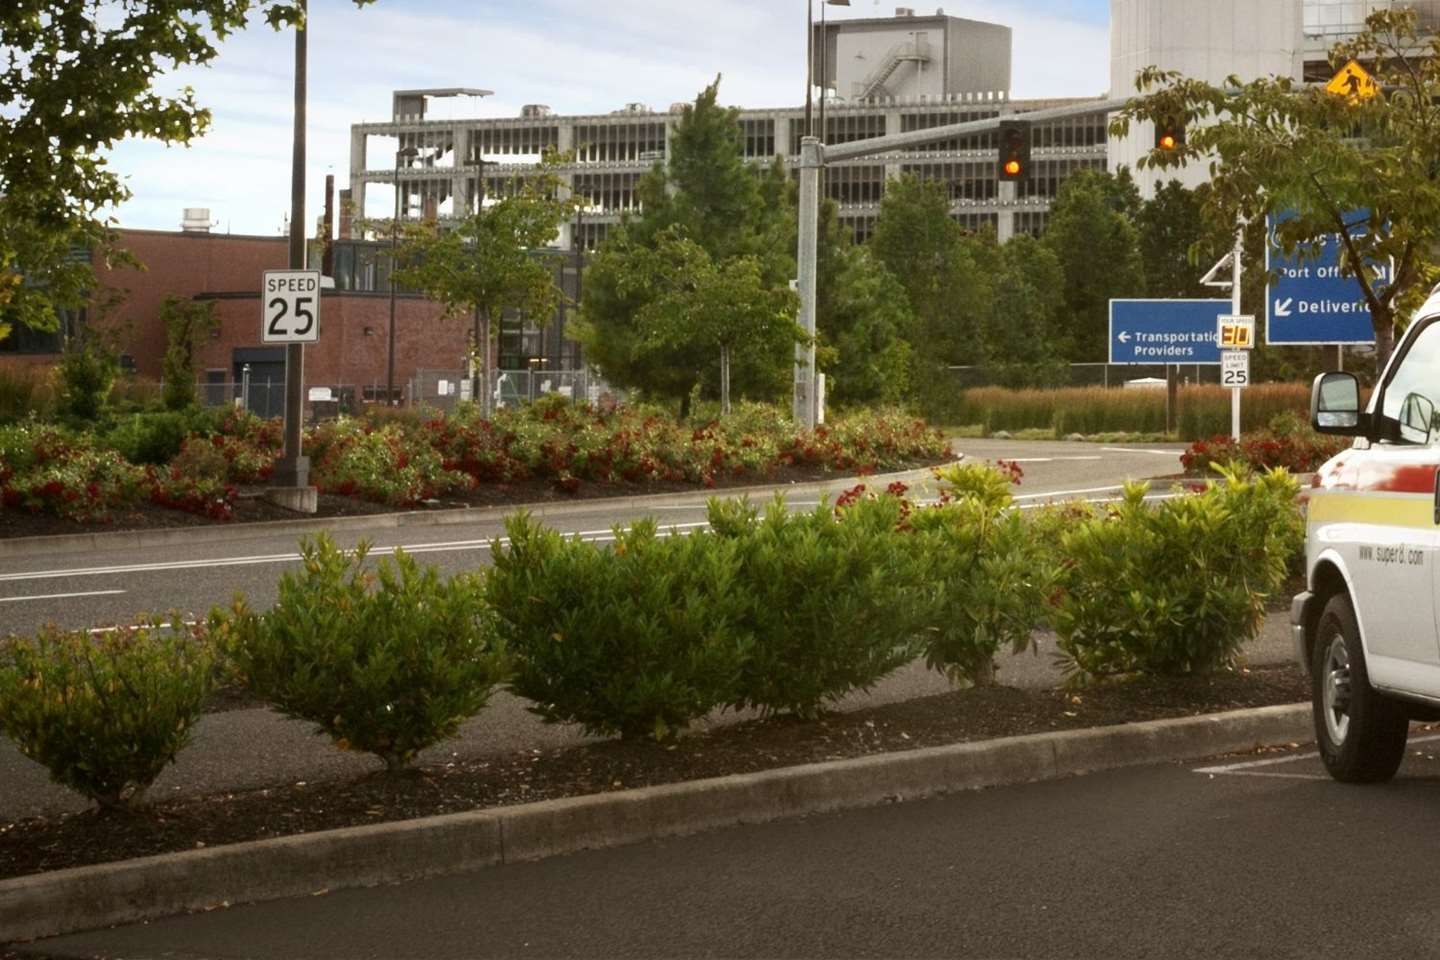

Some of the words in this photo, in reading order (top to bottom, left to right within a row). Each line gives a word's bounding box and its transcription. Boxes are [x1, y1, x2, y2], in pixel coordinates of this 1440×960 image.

[267, 278, 316, 292] SPEED
[1298, 300, 1371, 313] Deliveri
[267, 297, 314, 335] 25
[1135, 331, 1218, 344] Transportatio
[1134, 345, 1194, 356] Providers
[1224, 370, 1247, 384] 25
